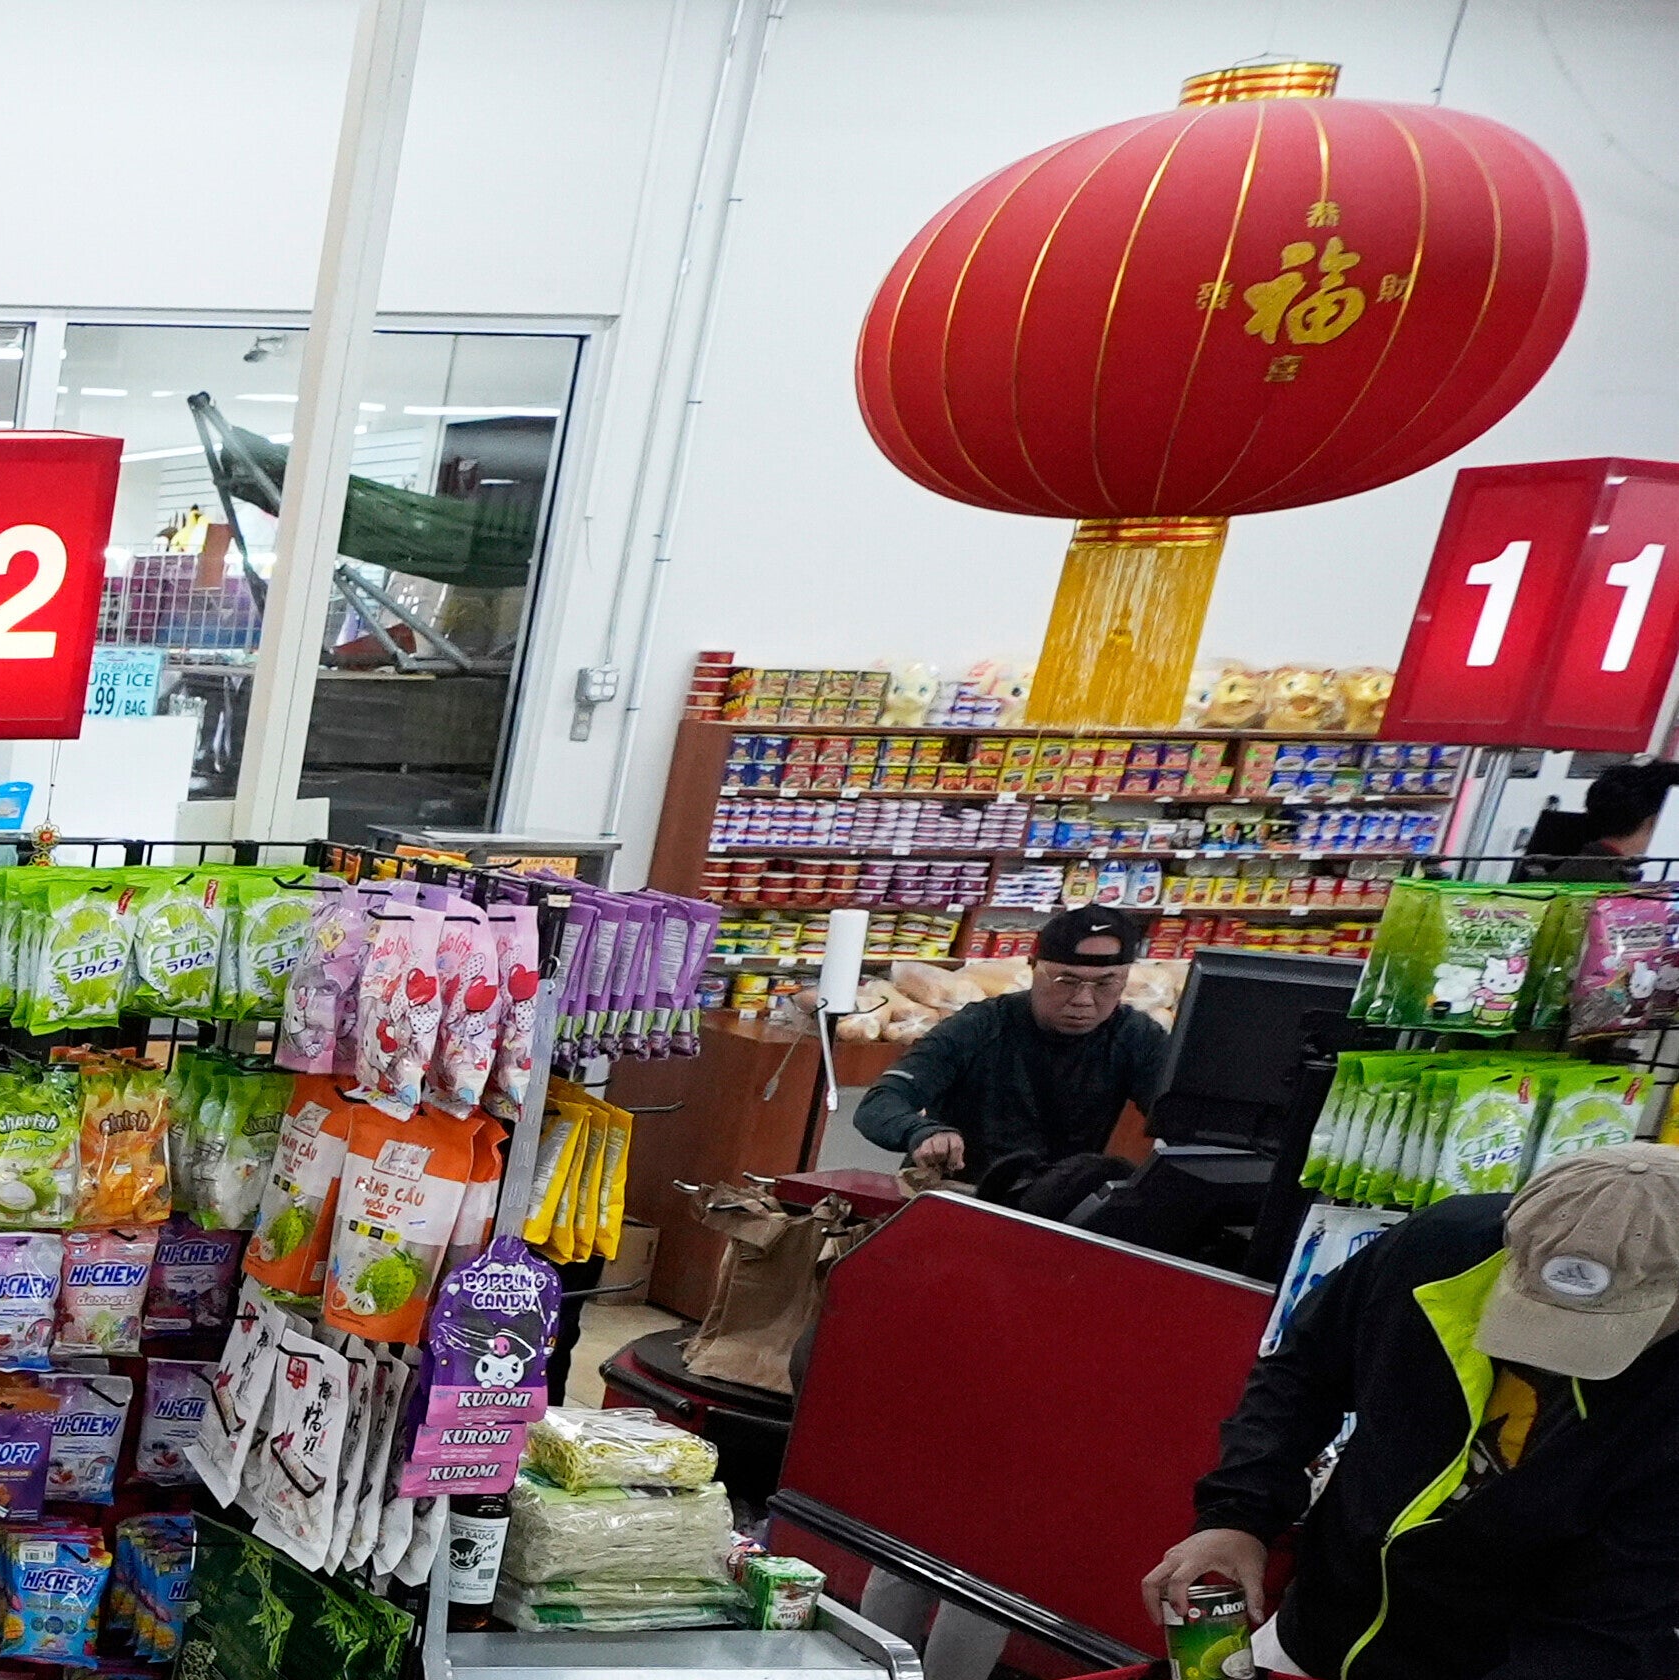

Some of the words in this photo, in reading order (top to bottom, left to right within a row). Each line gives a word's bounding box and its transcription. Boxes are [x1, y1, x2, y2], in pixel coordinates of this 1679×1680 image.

[1244, 241, 1365, 345] 福
[1464, 541, 1532, 668] 1
[1603, 545, 1665, 674] 1
[88, 672, 122, 686] URE
[126, 673, 154, 687] ICE
[156, 1243, 232, 1265] HI-CHEW
[67, 1263, 148, 1287] HI-CHEW
[463, 1270, 548, 1292] POPPING
[76, 1292, 135, 1308] dessert
[471, 1294, 539, 1311] CANDY
[456, 1391, 533, 1409] KUROMI
[440, 1428, 512, 1446] KUROMI
[427, 1463, 501, 1482] KUROMI
[467, 1529, 497, 1541] SAUCE
[21, 1568, 97, 1595] HI-CHEW
